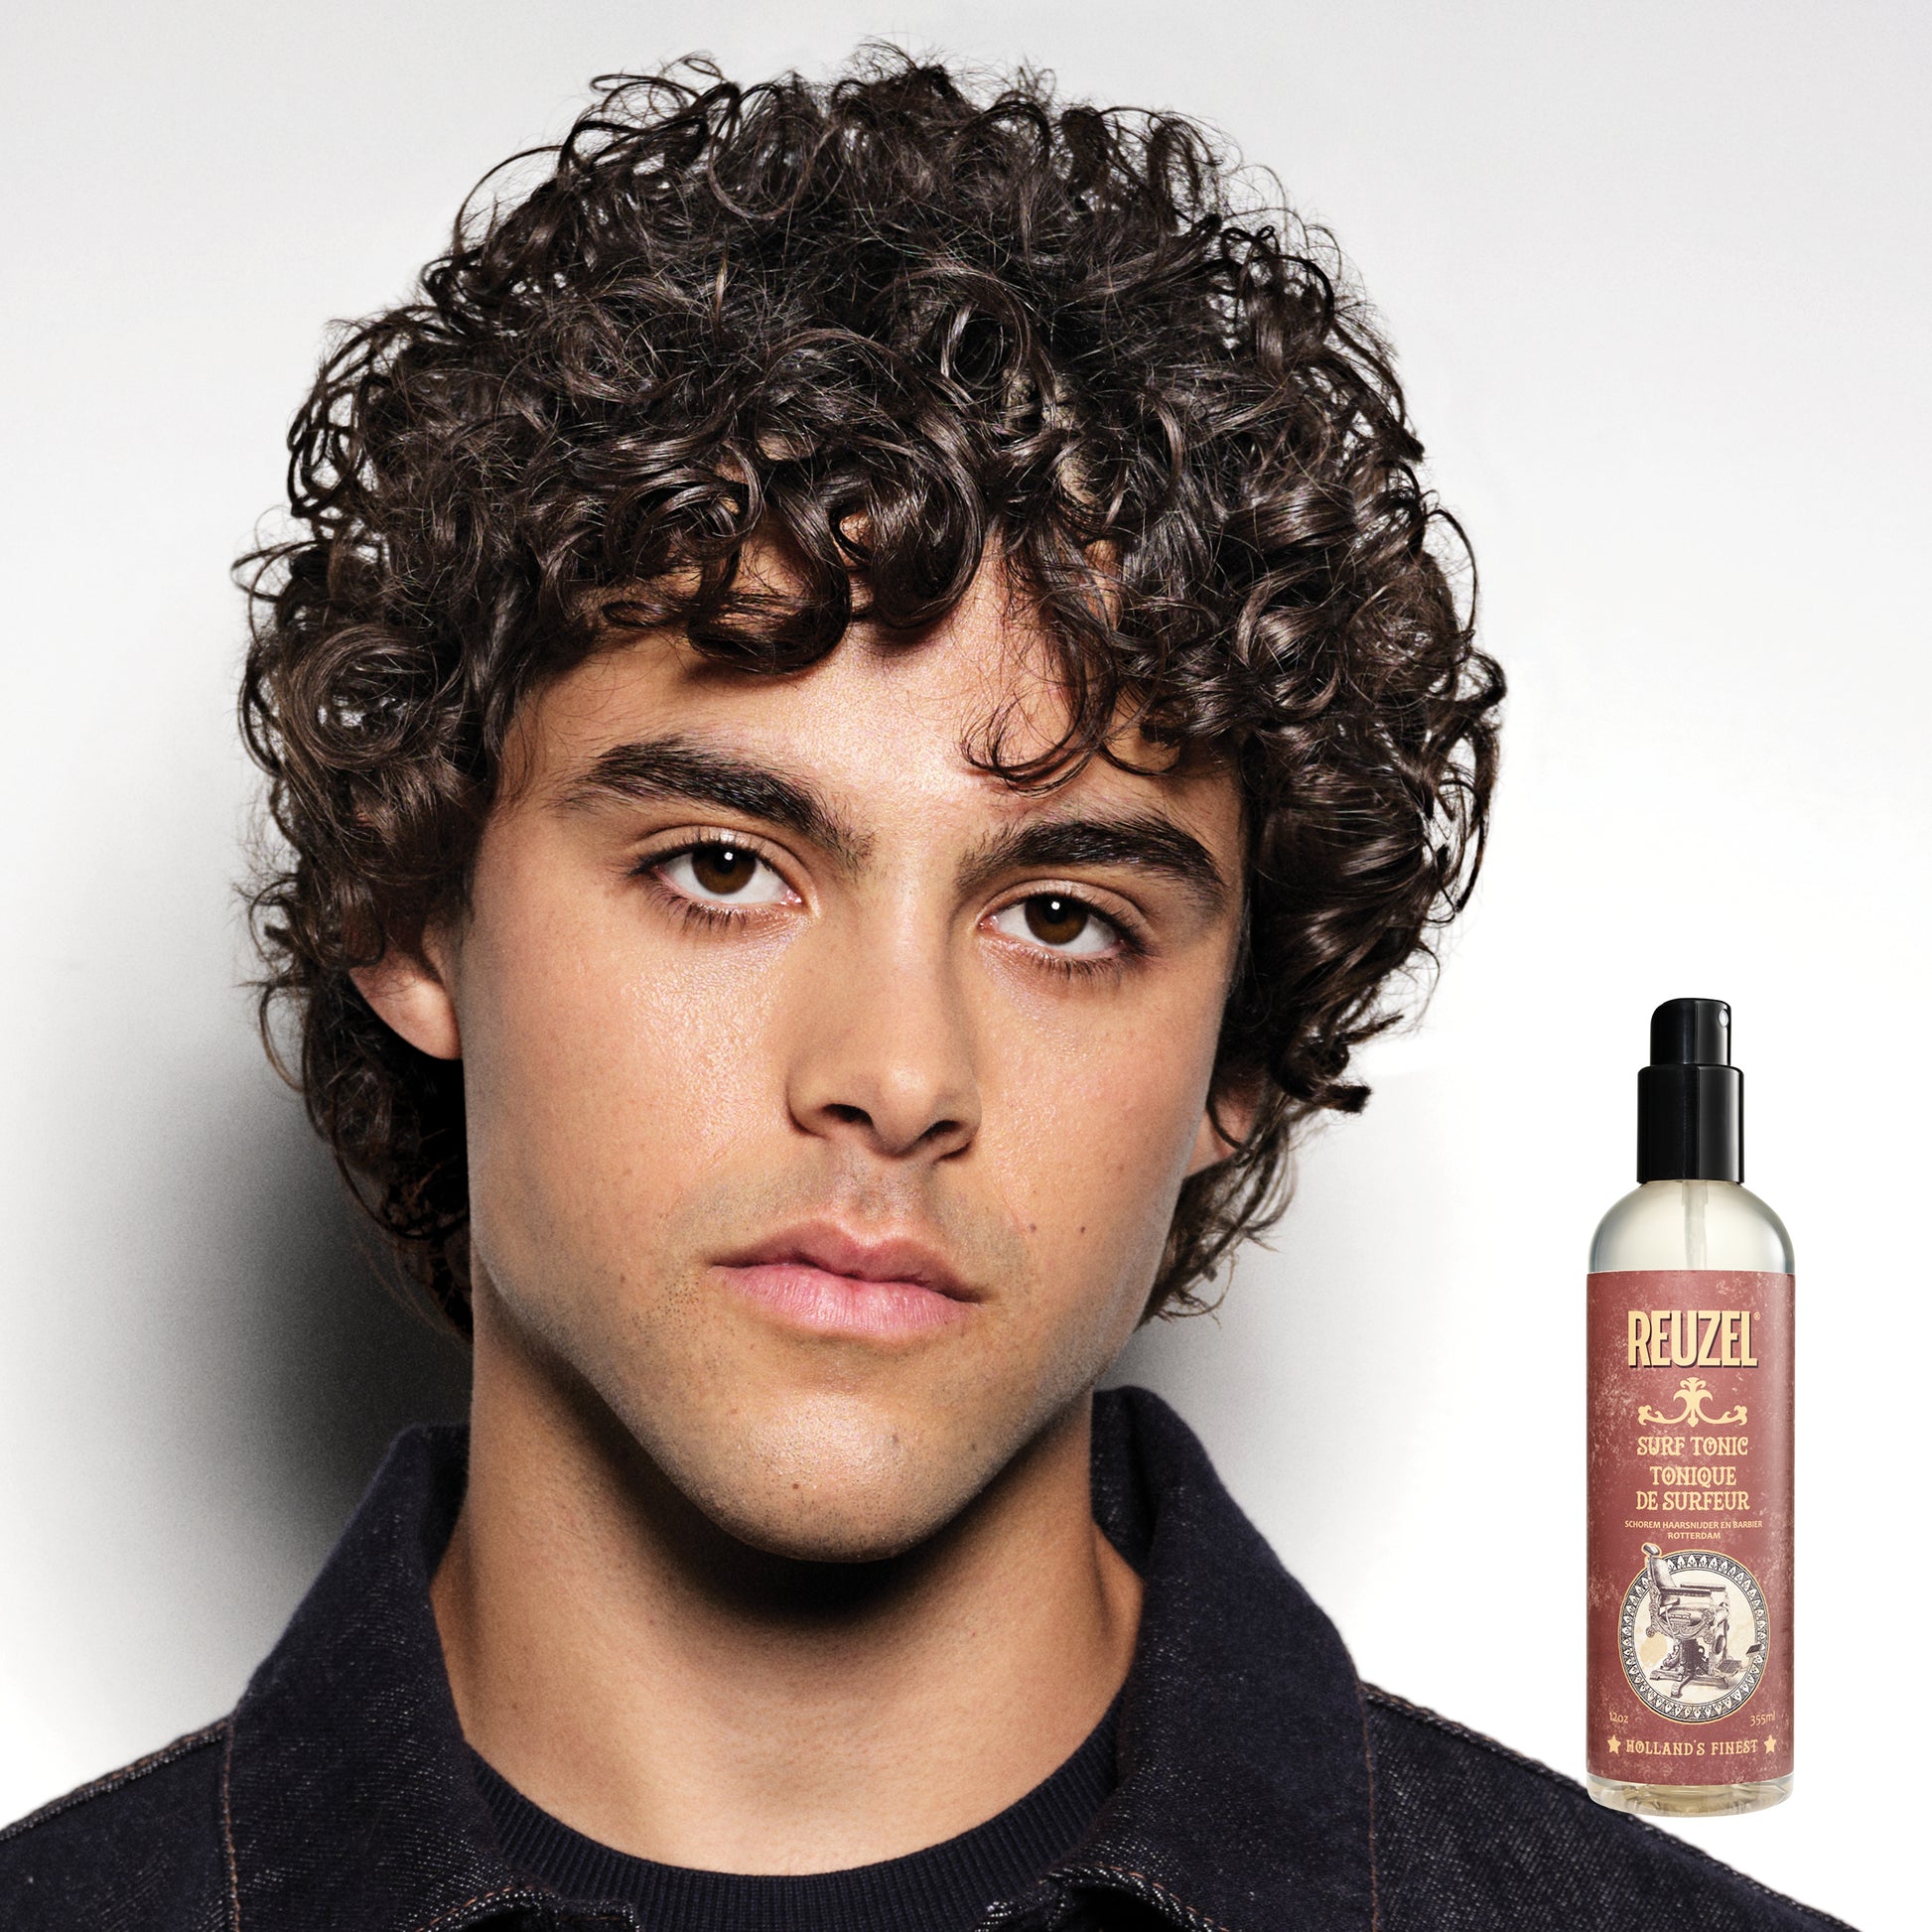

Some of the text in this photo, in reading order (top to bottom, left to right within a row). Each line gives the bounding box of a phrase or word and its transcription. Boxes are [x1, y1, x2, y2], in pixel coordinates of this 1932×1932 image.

[1637, 1436, 1748, 1455] SURF TONIC
[1650, 1465, 1736, 1488] TONIQUE
[1635, 1490, 1750, 1511] DE SURFEUR
[1624, 1520, 1661, 1529] SCHOREM
[1662, 1520, 1719, 1530] HAARSNIJDER
[1732, 1520, 1762, 1529] BARBIER
[1608, 1712, 1628, 1724] 12oz
[1750, 1711, 1776, 1726] 355ml
[1626, 1739, 1758, 1756] HOLLAND'S FINEST
